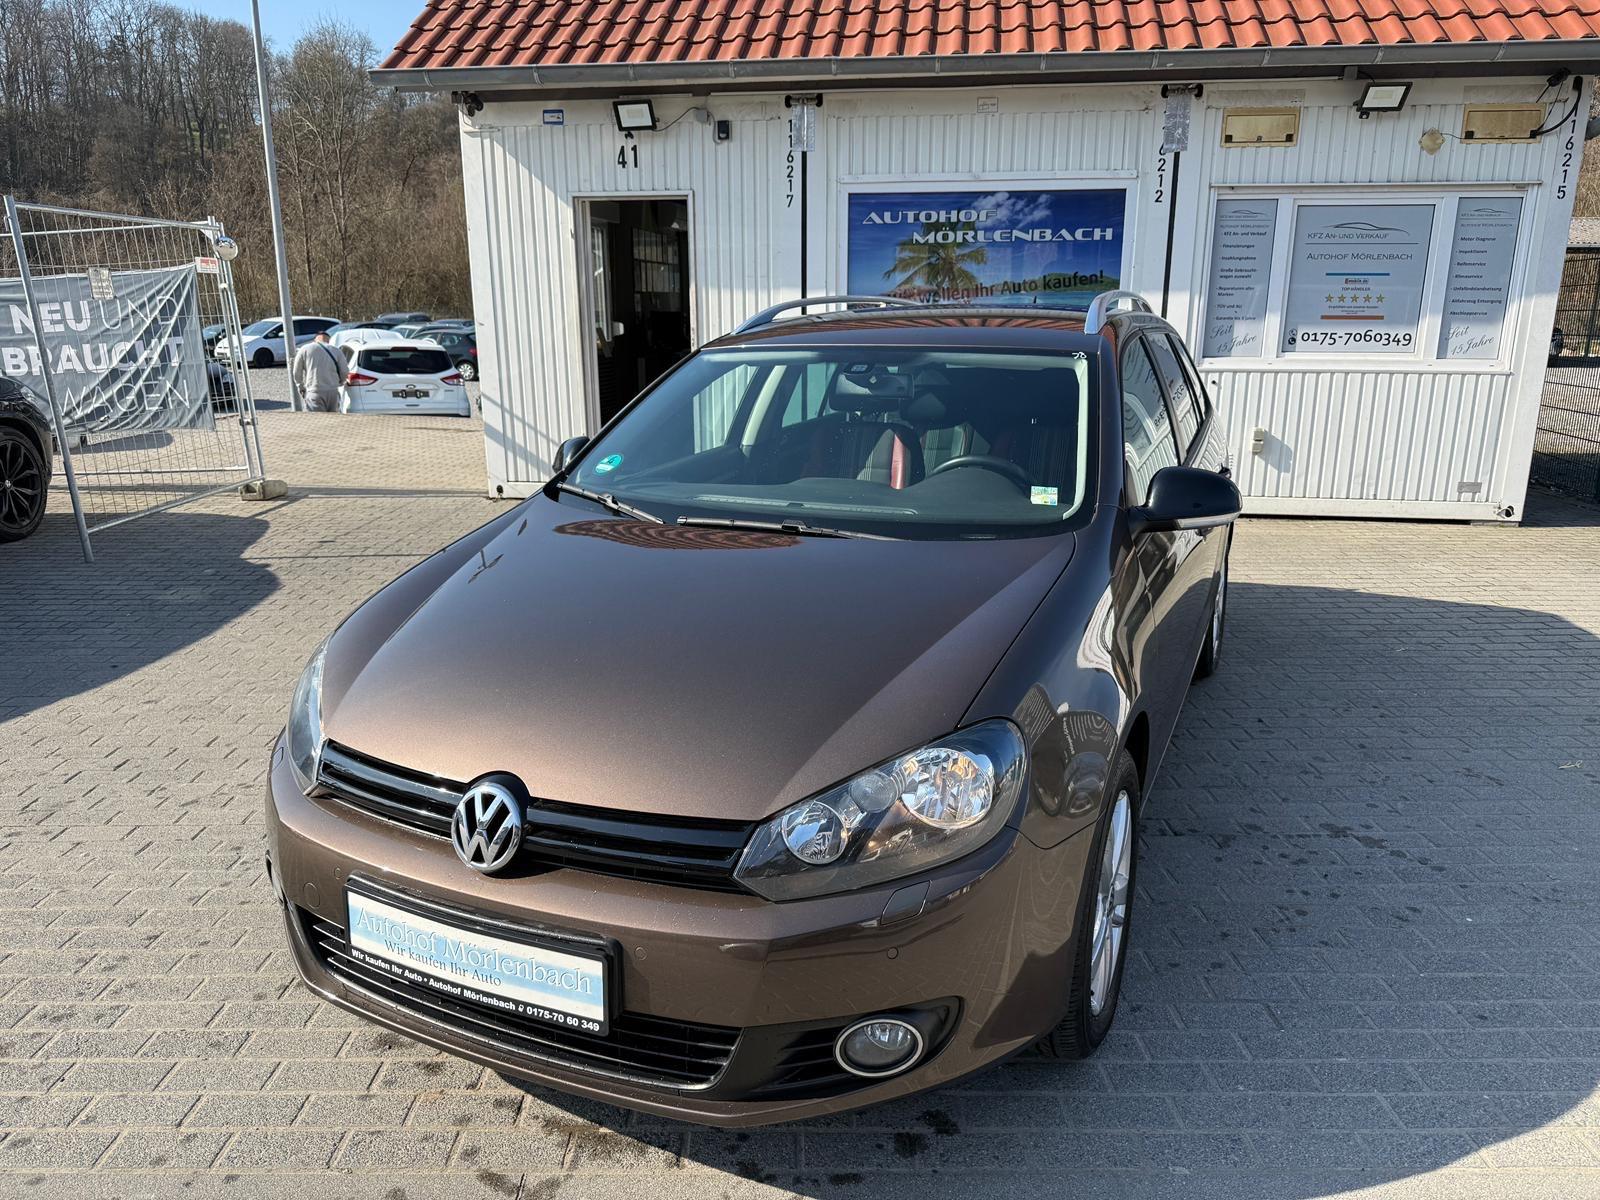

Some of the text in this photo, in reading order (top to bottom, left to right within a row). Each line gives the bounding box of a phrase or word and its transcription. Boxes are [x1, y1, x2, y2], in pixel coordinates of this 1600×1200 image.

[617, 145, 638, 168] 41
[786, 119, 794, 208] 116217
[862, 209, 997, 225] AUTOHOF
[912, 226, 1113, 244] MÖRLENBACH
[1307, 232, 1323, 240] KFZ
[975, 282, 995, 298] Ihr
[1000, 279, 1038, 295] Auto
[1042, 269, 1104, 290] kaufen!
[9, 295, 178, 334] NEU UND
[0, 336, 184, 377] BRAUCHT
[1301, 329, 1412, 346] 0175-7060349
[56, 377, 190, 416] WAGEN
[357, 906, 593, 995] Autohof Mörlenbach
[384, 939, 502, 987] Wir kaufen Ihr Auto
[351, 948, 600, 1031] Wir kaufen Ihr Auto Autohof Mörlenbach 0175-70 60 349
